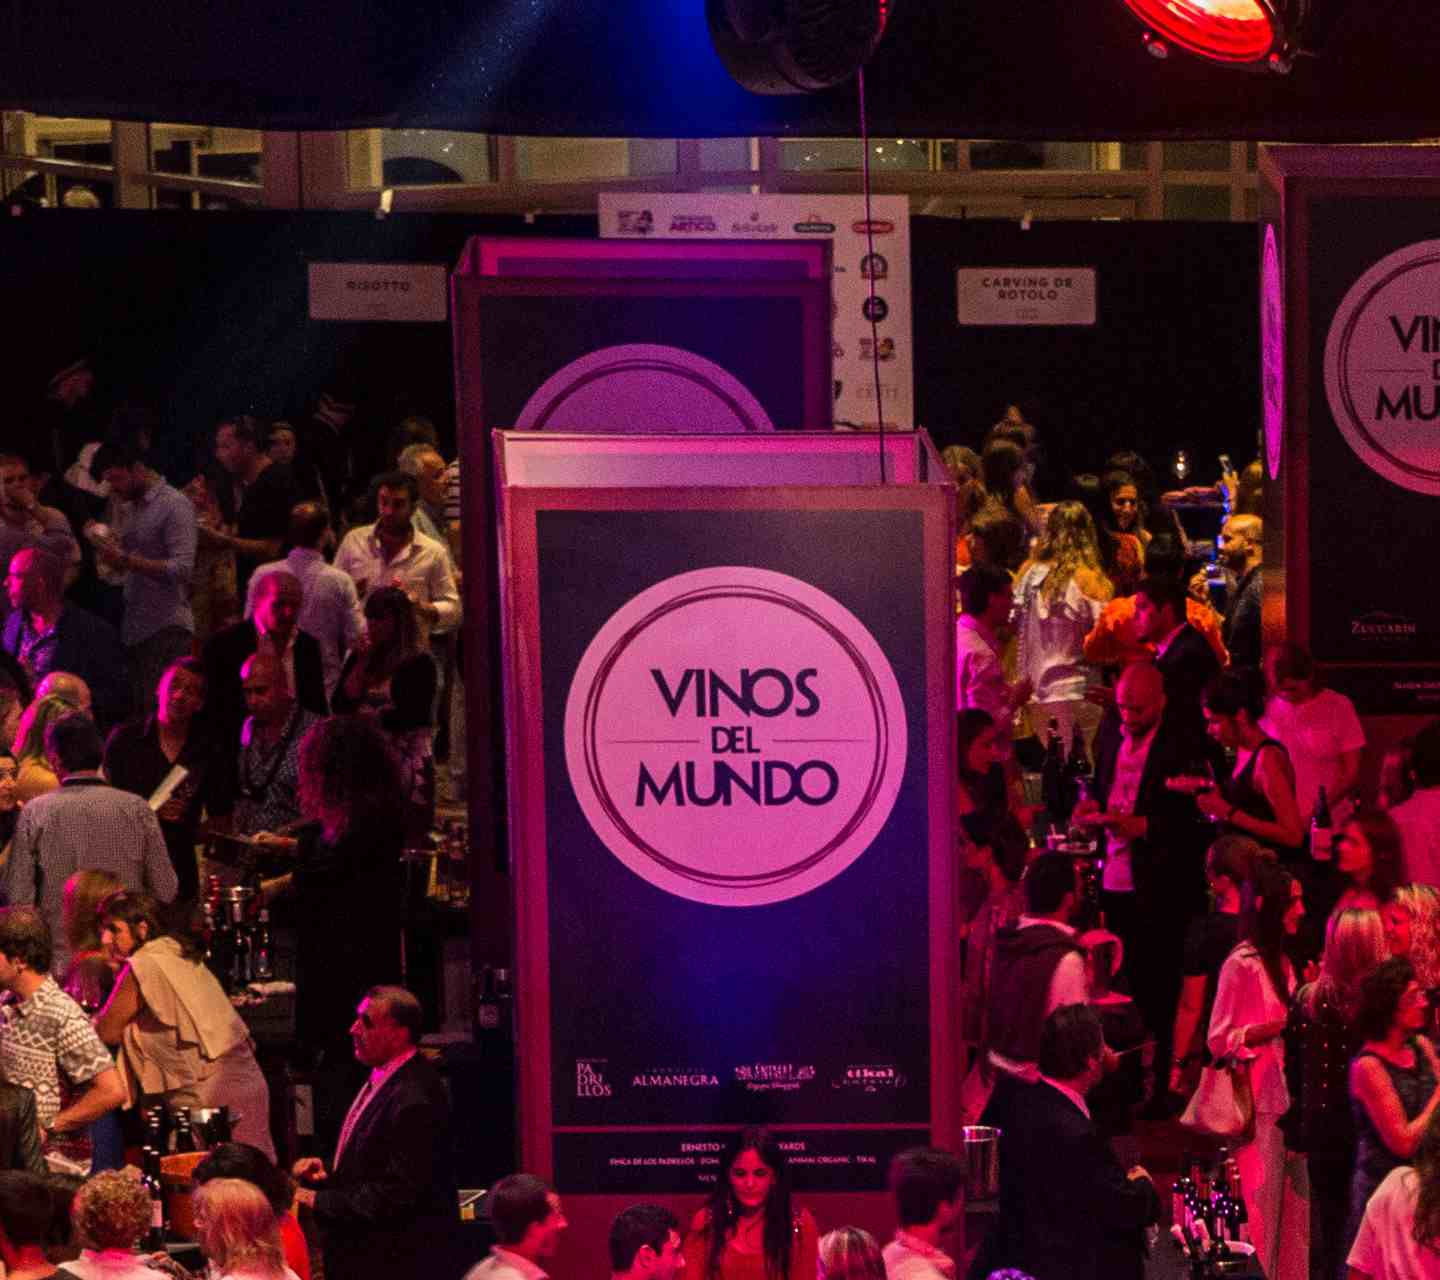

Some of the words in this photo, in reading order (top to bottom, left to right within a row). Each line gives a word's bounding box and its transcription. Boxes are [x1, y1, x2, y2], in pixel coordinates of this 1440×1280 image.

[982, 278, 1049, 288] CARVING
[1054, 278, 1073, 288] DE
[998, 289, 1058, 300] ROTOLO
[650, 667, 821, 718] VINOS
[710, 725, 761, 754] DEL
[634, 760, 840, 807] MUNDO
[633, 1074, 719, 1087] ALMANEGRA
